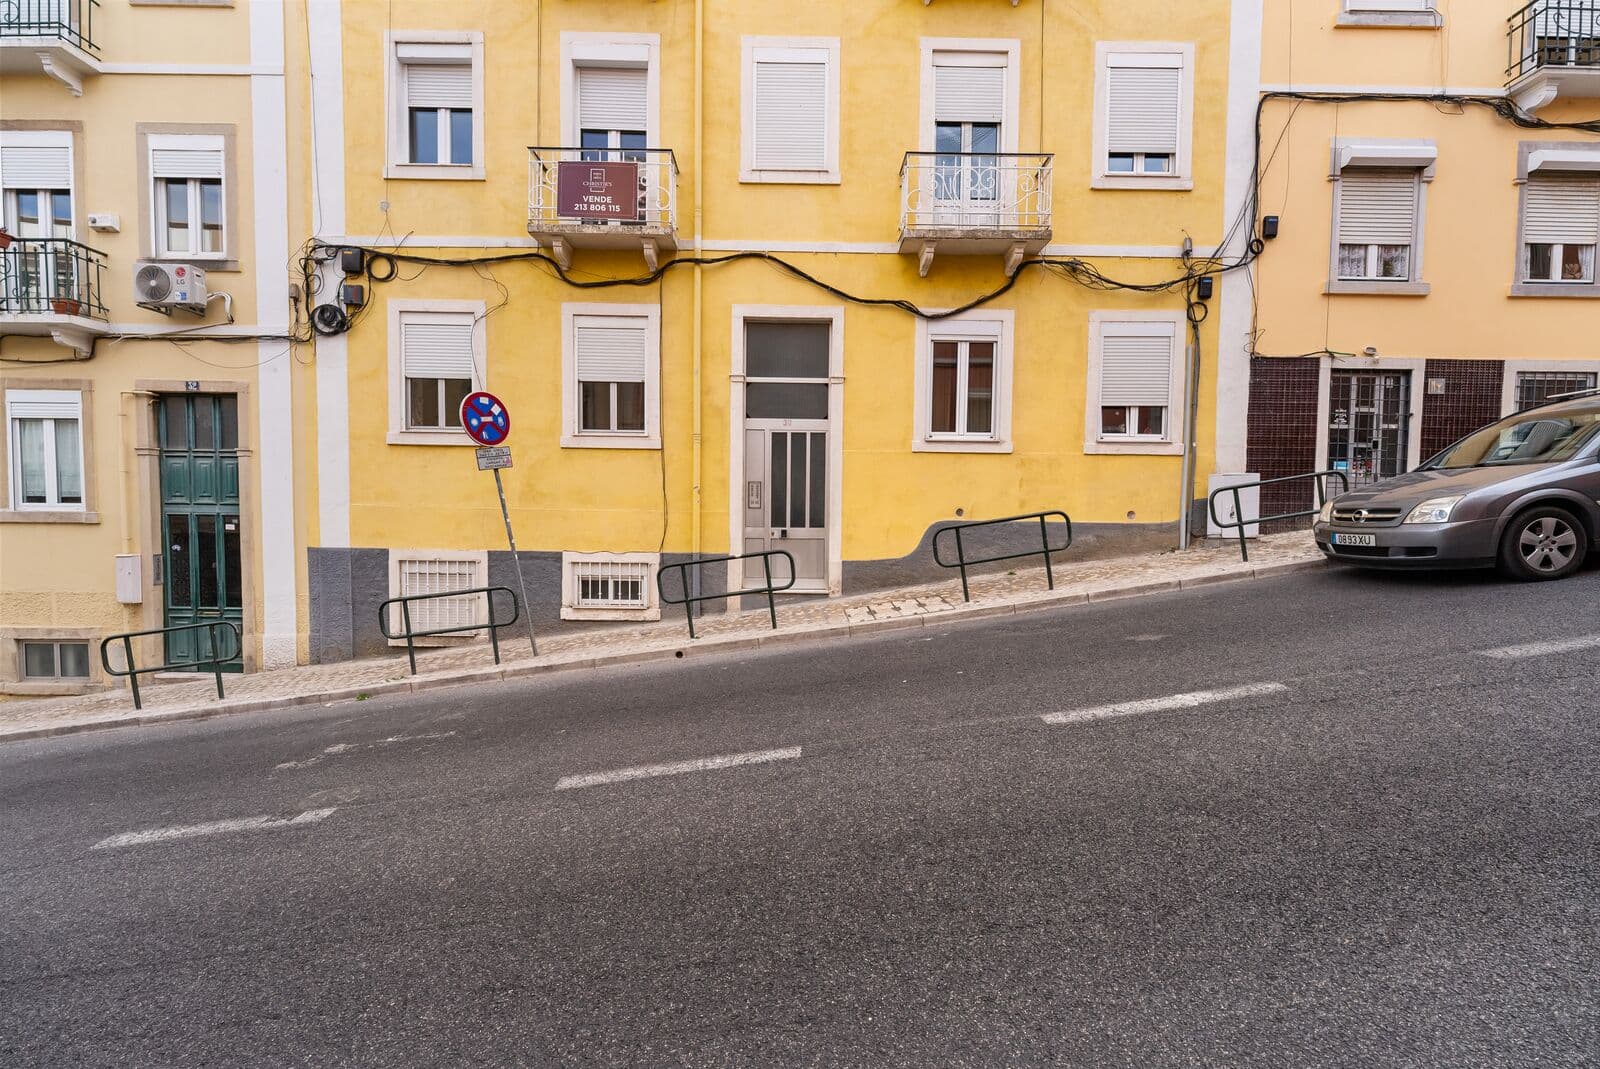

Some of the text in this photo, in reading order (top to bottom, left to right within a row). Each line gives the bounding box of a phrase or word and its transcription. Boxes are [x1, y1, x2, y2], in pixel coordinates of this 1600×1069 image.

[583, 195, 612, 203] VENDE
[574, 203, 588, 211] 213
[609, 204, 621, 212] 115
